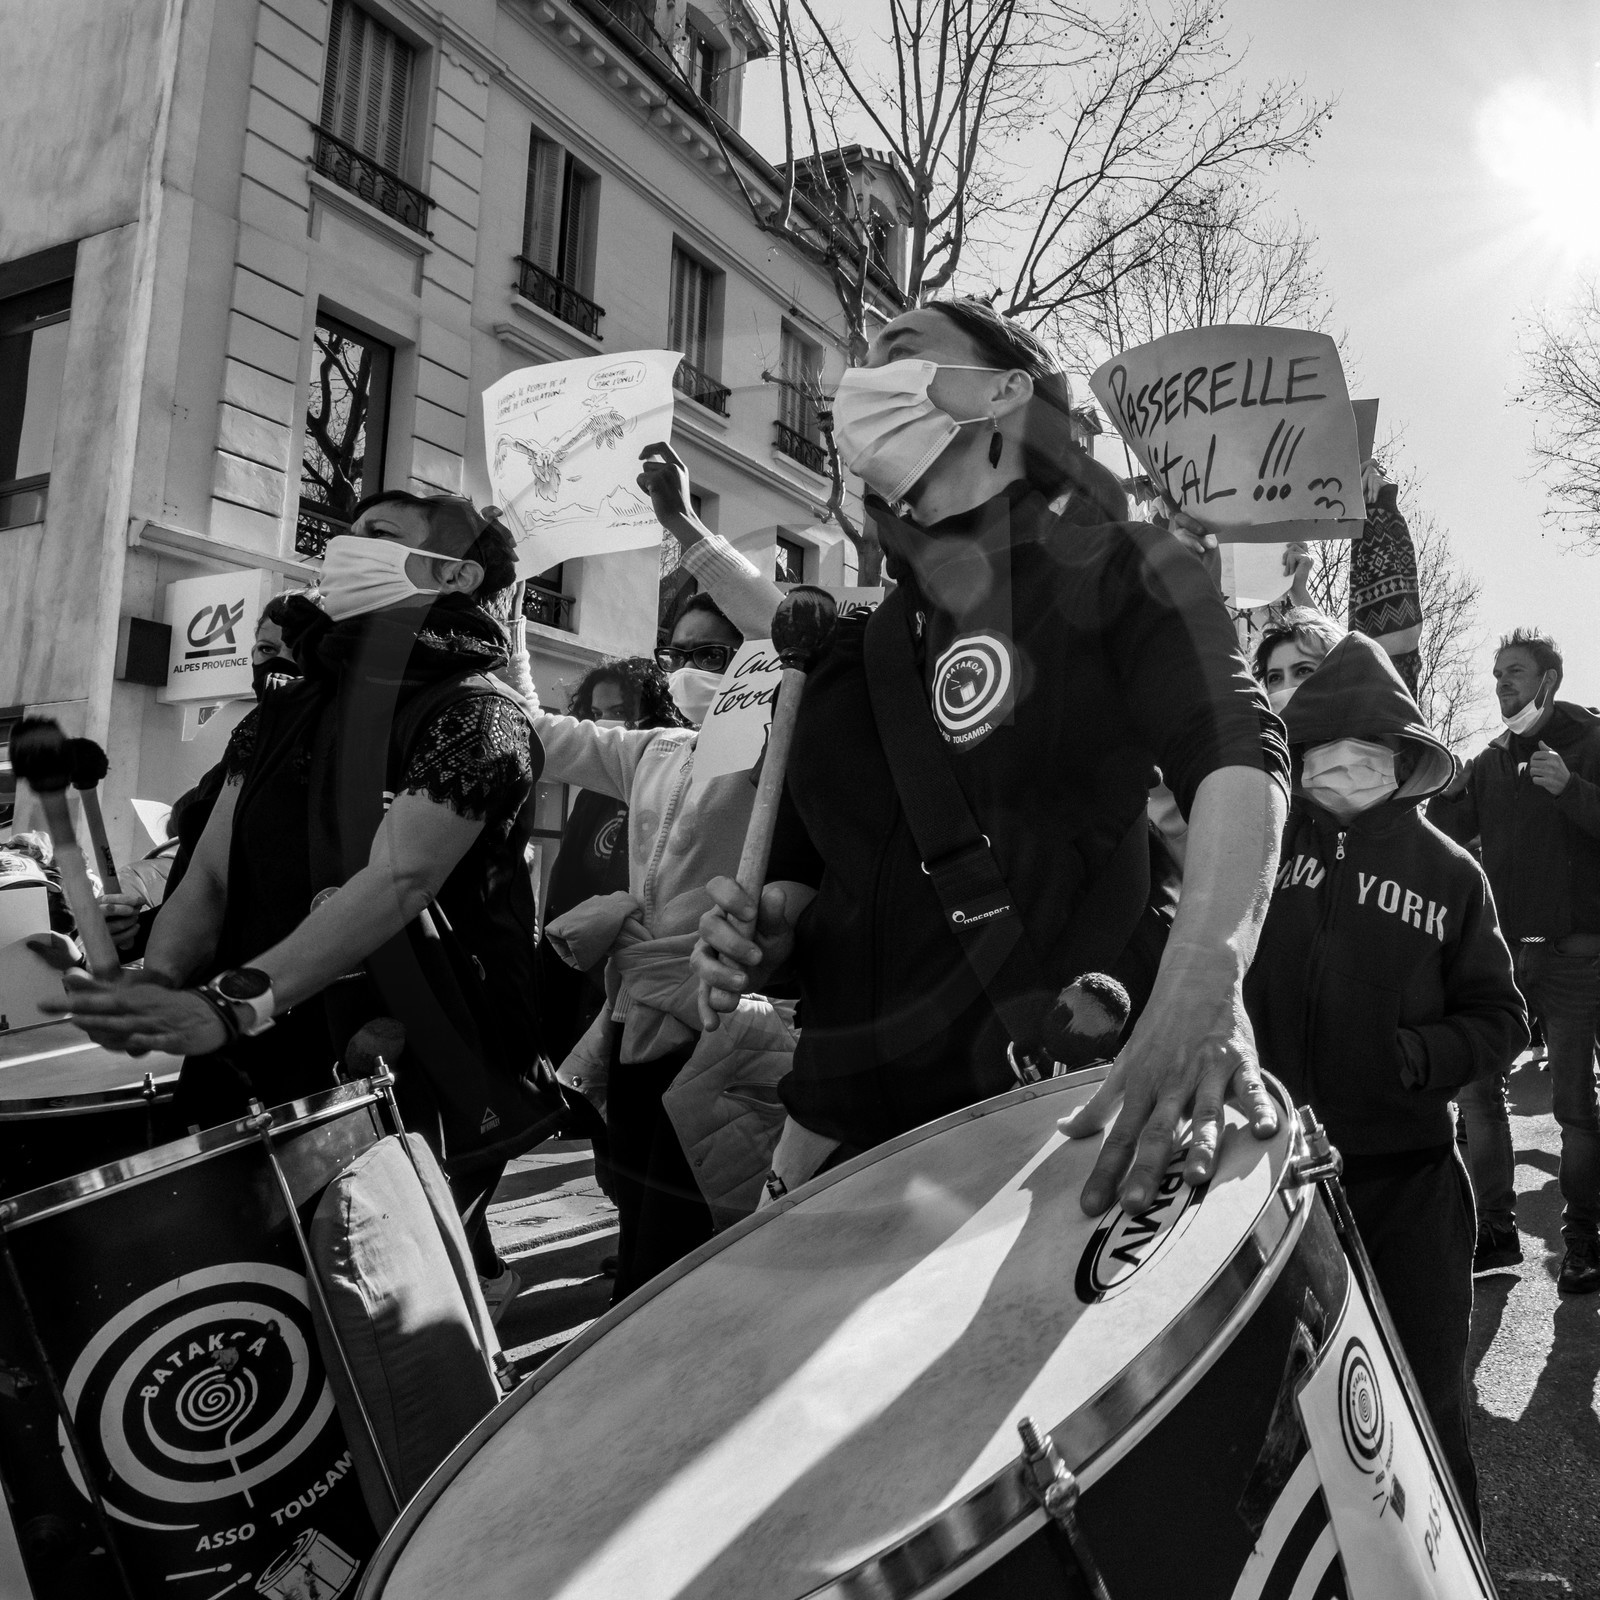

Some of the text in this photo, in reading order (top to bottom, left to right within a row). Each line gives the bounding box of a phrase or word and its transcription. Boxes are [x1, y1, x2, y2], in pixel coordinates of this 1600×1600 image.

[1107, 356, 1327, 440] PASSERELLE
[173, 657, 248, 673] ALPES PROVENCE
[945, 660, 983, 679] BATAKOA
[952, 722, 992, 744] TOUSAMBA
[1358, 872, 1448, 942] YORK
[140, 1332, 267, 1398] BATAKA
[195, 1523, 256, 1552] ASSO
